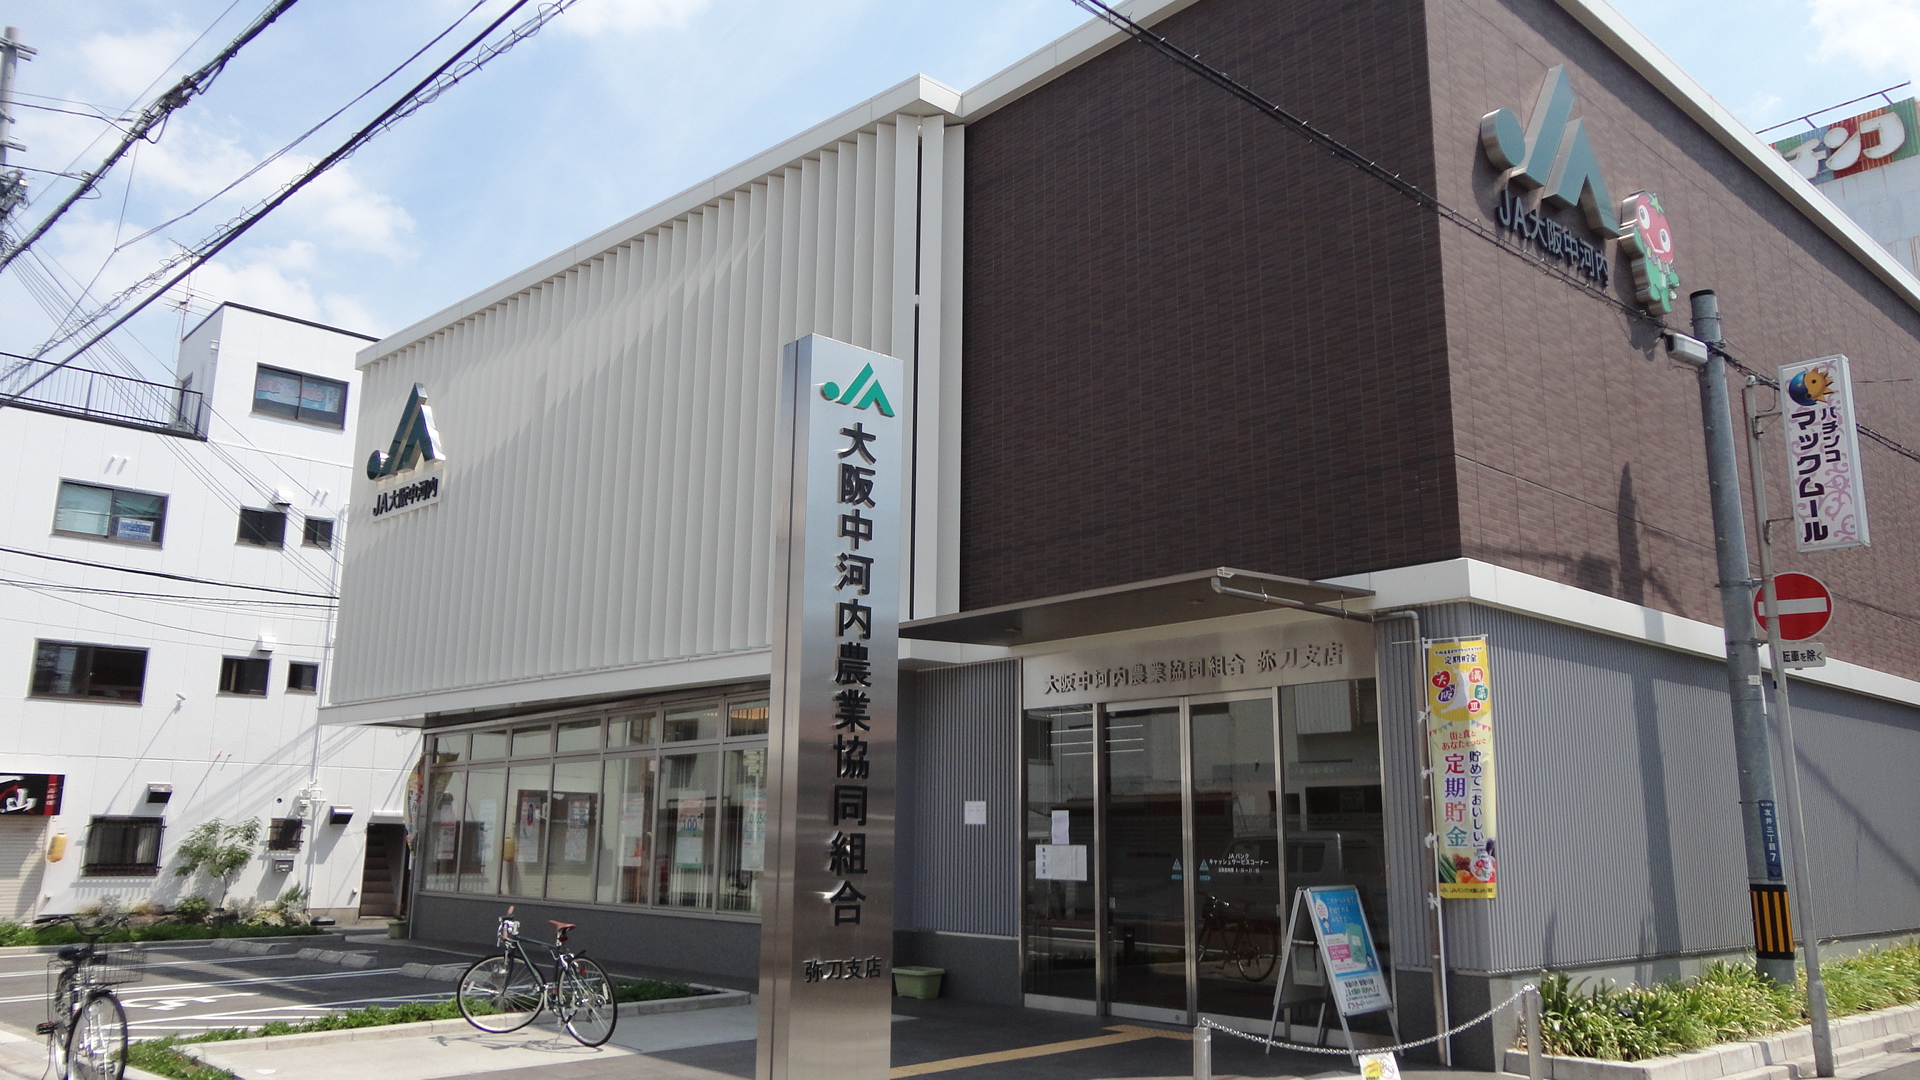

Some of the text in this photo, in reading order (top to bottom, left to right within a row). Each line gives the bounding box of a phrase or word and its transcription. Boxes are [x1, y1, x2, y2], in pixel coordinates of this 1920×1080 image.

[1497, 189, 1609, 287] JA大阪中河内
[1820, 405, 1841, 462] パチンコ
[373, 477, 439, 517] JA大阪中河内
[1790, 409, 1829, 543] マックムール
[828, 422, 877, 926] 大阪中河内農業協同組合
[1043, 641, 1344, 695] 大阪中河内農業協同組合 弥刀支店
[1444, 653, 1477, 665] 定期貯金
[1782, 649, 1823, 663] 転車を除く
[1444, 753, 1468, 847] 定期貯金
[1469, 750, 1484, 848] 貯めて「おいしい」
[804, 956, 882, 983] 弥刀支店
